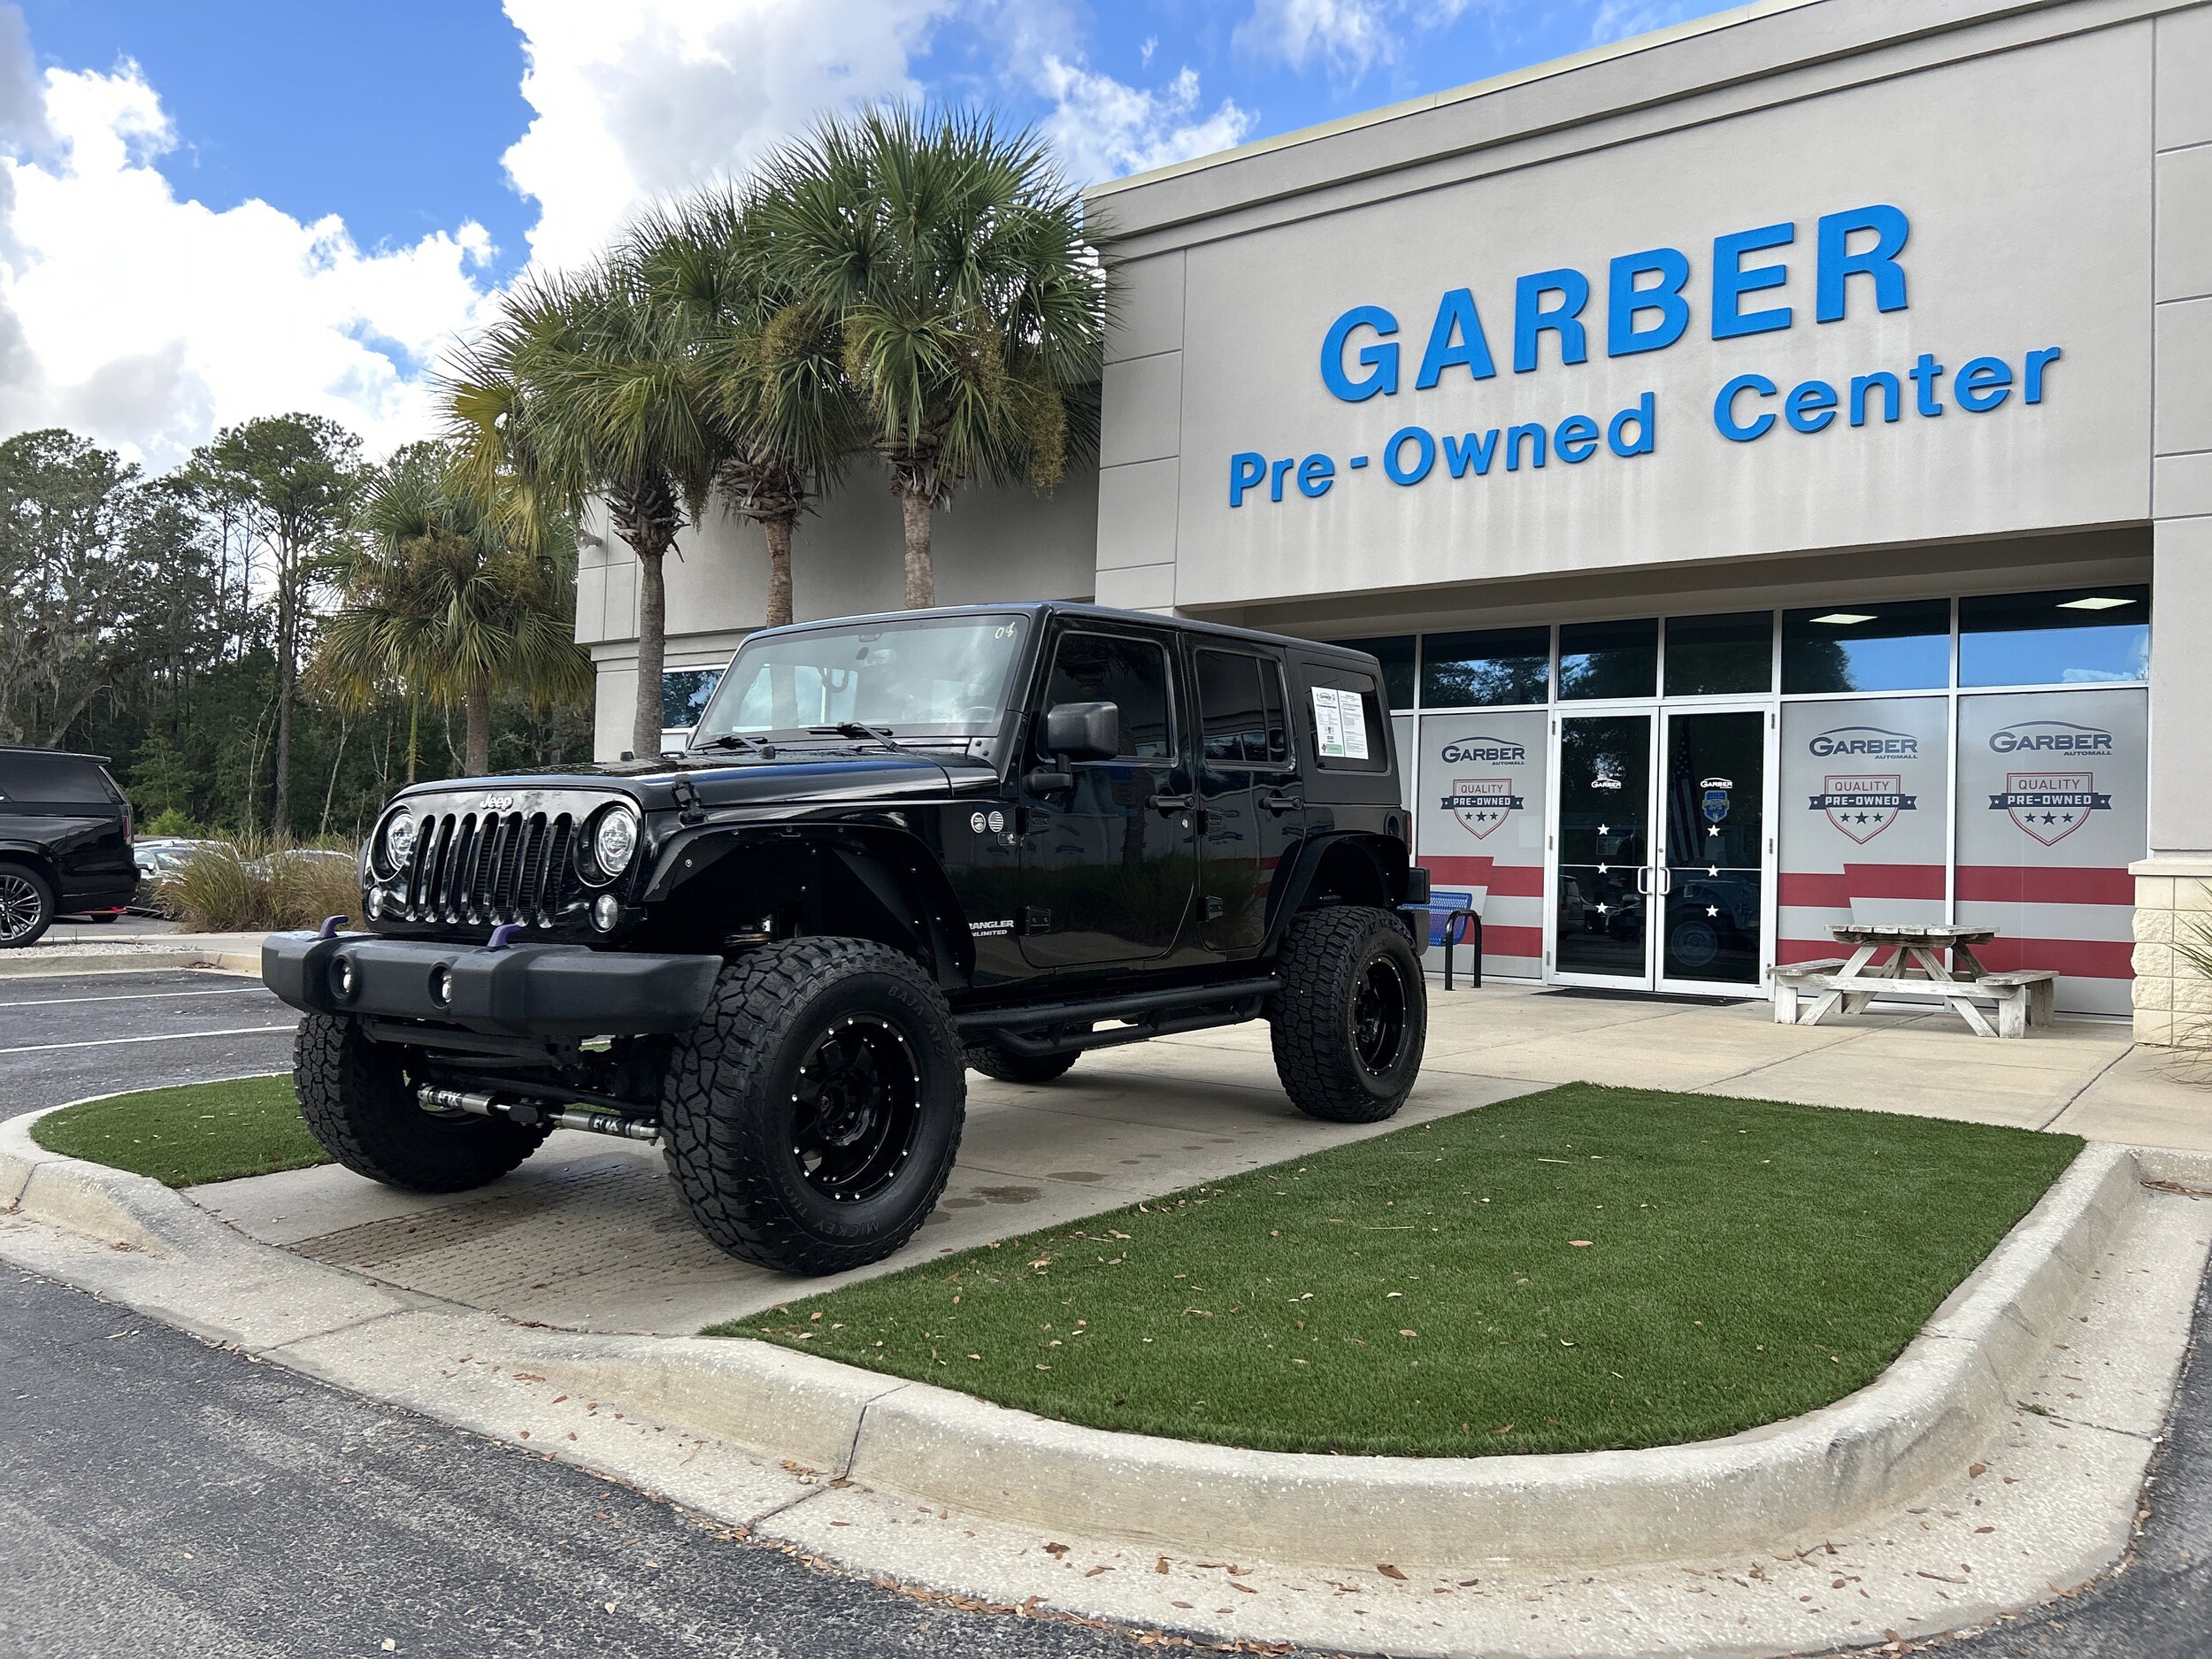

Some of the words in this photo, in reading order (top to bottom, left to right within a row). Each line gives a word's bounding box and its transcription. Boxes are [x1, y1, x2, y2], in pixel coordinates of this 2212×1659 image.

[1320, 204, 1910, 403] GARBER
[1713, 346, 2063, 442] Center
[1809, 736, 1918, 757] GARBER
[1989, 732, 2112, 753] GARBER
[1441, 745, 1525, 764] GARBER
[1461, 784, 1503, 794] QUALITY
[1591, 780, 1622, 789] GARBER
[1700, 780, 1733, 789] GARBER
[1835, 781, 1890, 791] QUALITY
[2018, 780, 2080, 790] QUALITY
[480, 793, 513, 811] Jeep
[1453, 797, 1510, 806] PRE-OWNED
[1825, 796, 1900, 805] PRE-OWNED
[2007, 795, 2092, 805] PRE-OWNED
[887, 984, 925, 1017] BAJA
[437, 1090, 463, 1107] FOX
[594, 1115, 623, 1133] FOX
[812, 1219, 879, 1238] MICKEY
